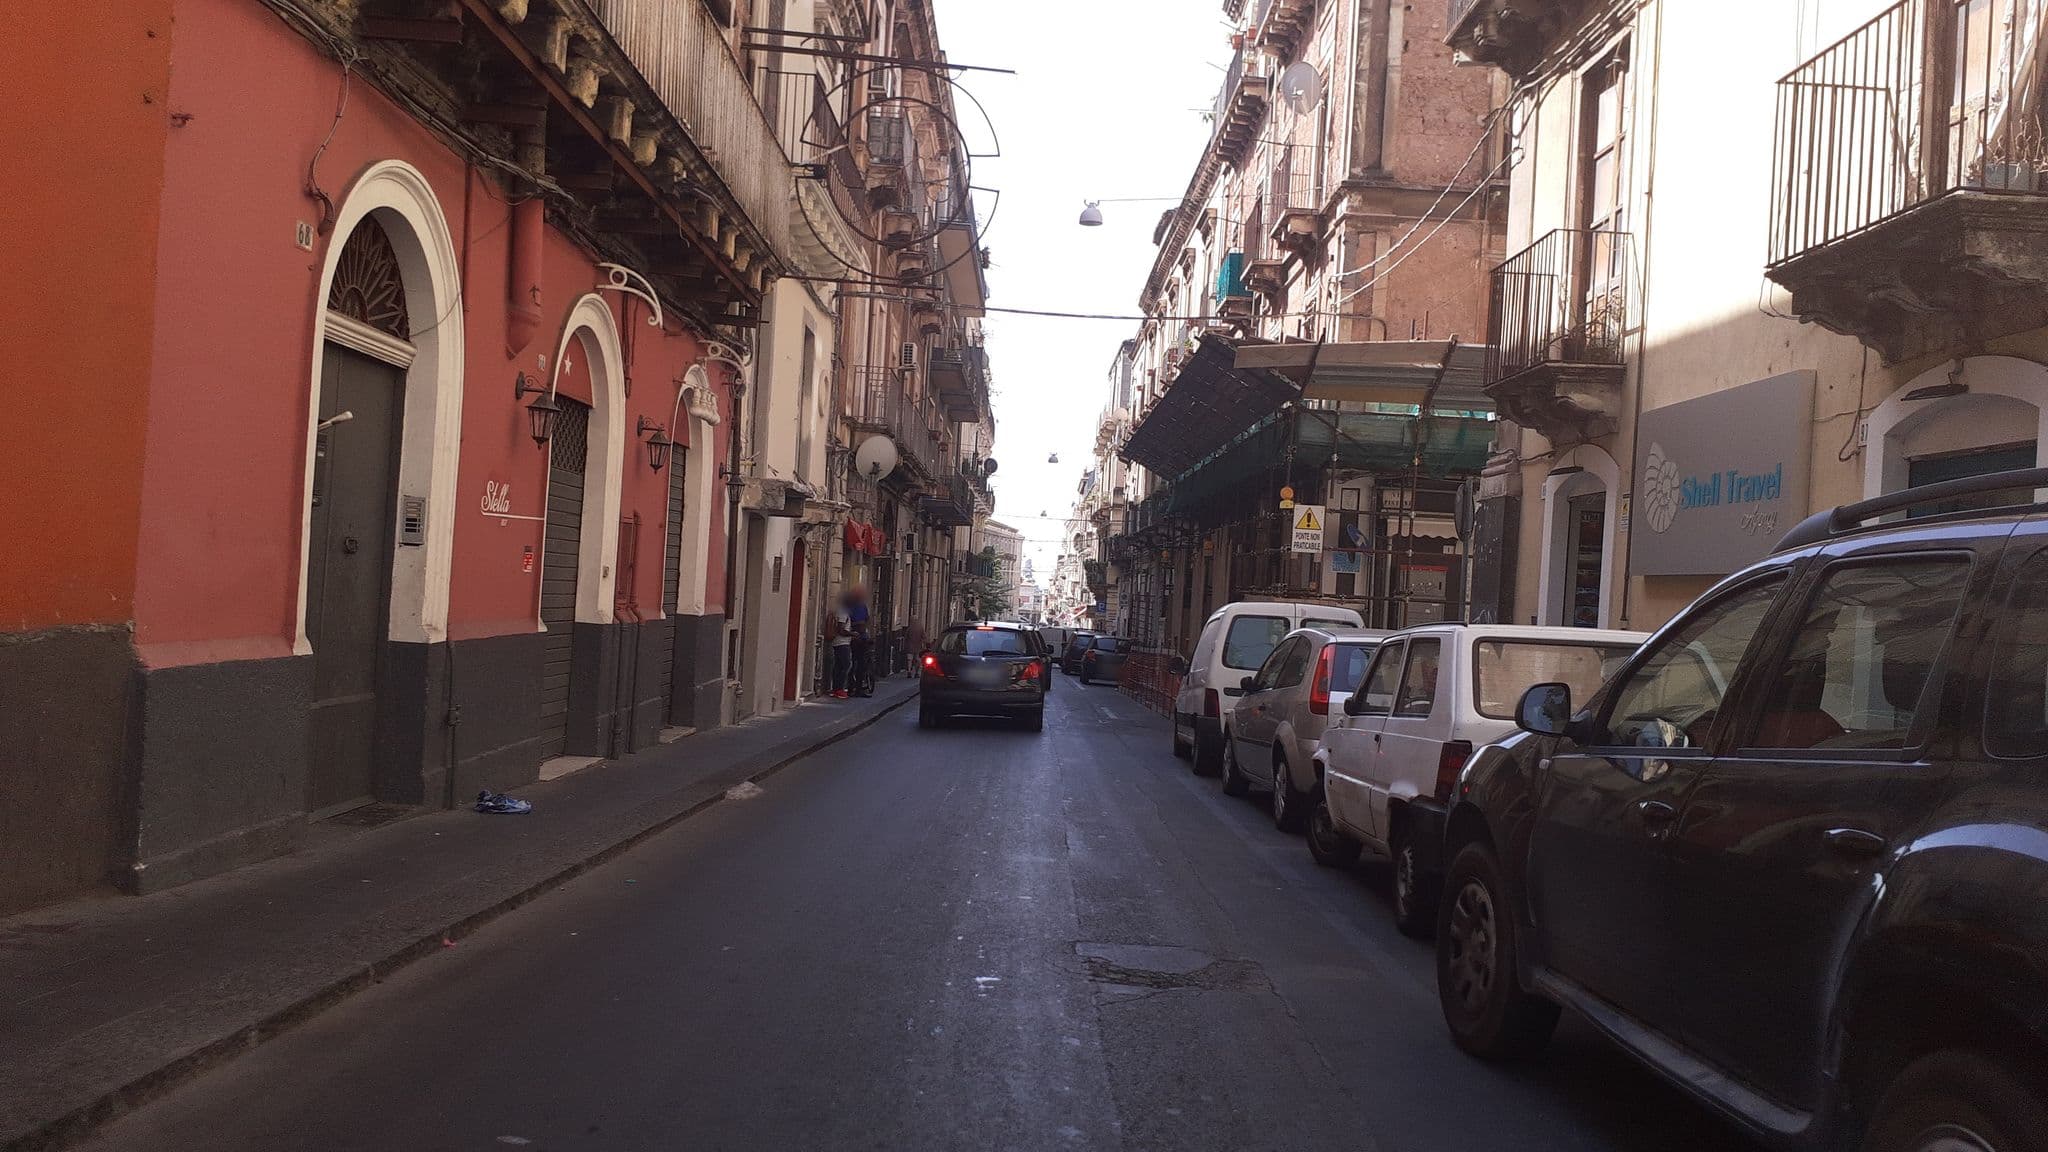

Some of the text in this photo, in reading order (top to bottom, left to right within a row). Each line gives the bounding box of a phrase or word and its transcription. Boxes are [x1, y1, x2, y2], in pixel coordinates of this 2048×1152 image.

[298, 223, 311, 246] 68
[480, 480, 510, 513] Stella
[1680, 462, 1782, 510] Shell Travel
[1292, 541, 1321, 551] PRATICABILE
[1295, 531, 1321, 542] PONTE NON
